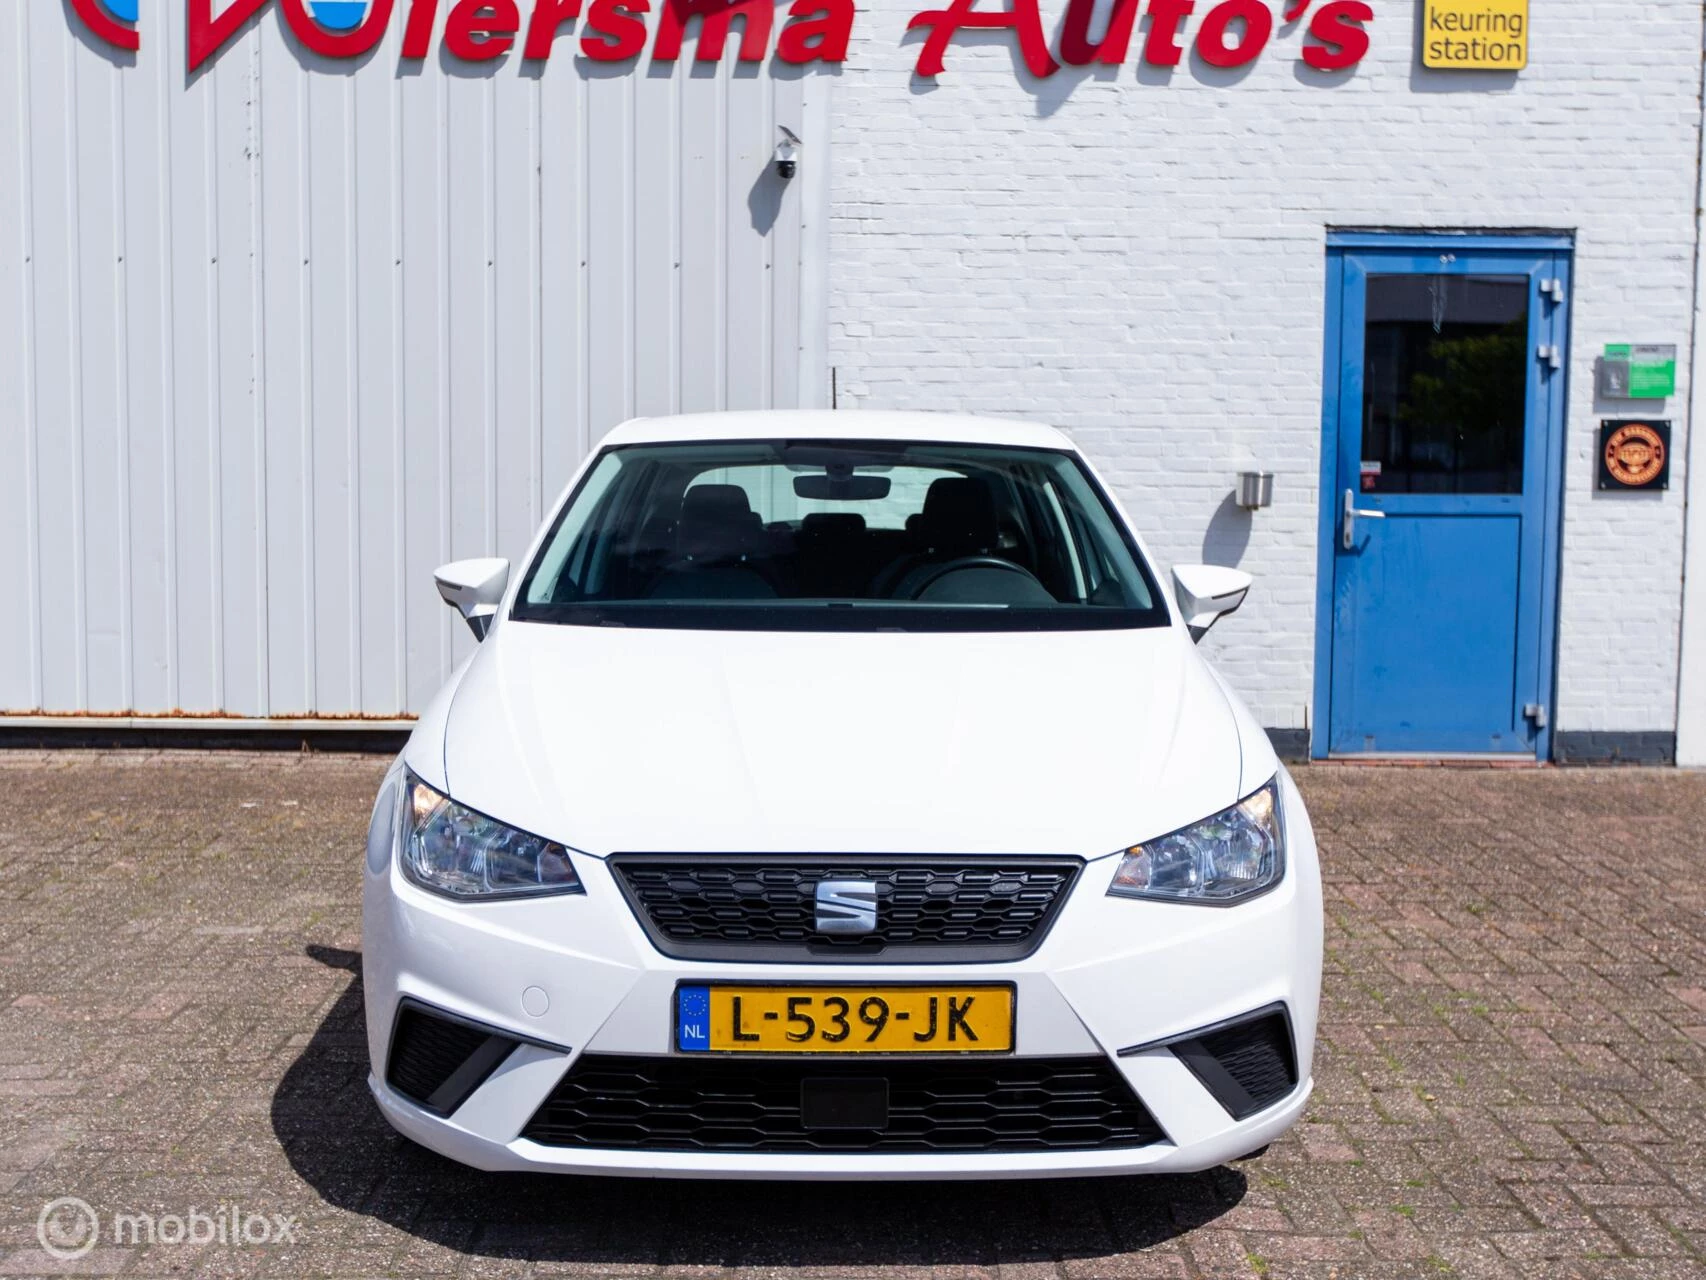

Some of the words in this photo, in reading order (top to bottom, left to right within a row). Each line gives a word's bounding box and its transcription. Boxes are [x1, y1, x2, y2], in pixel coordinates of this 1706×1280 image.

[1430, 6, 1523, 39] keuring
[1430, 38, 1522, 62] station
[684, 1024, 706, 1039] NL
[732, 996, 979, 1043] L-539-JK
